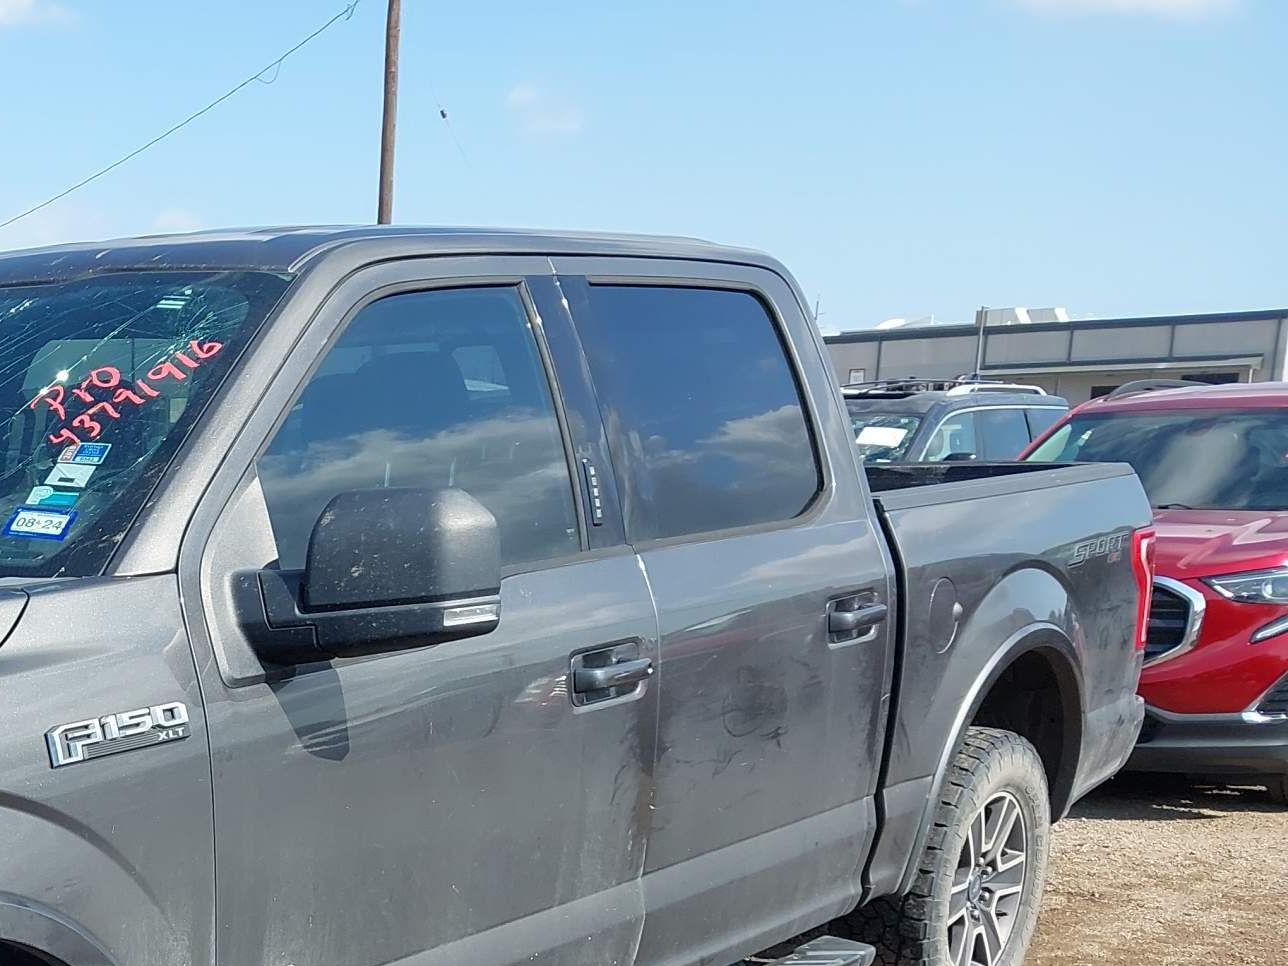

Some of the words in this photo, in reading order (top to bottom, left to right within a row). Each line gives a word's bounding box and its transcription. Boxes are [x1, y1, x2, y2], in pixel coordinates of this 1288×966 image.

[48, 339, 223, 446] 43791916
[1067, 532, 1129, 568] SPORT
[158, 726, 185, 741] XLT
